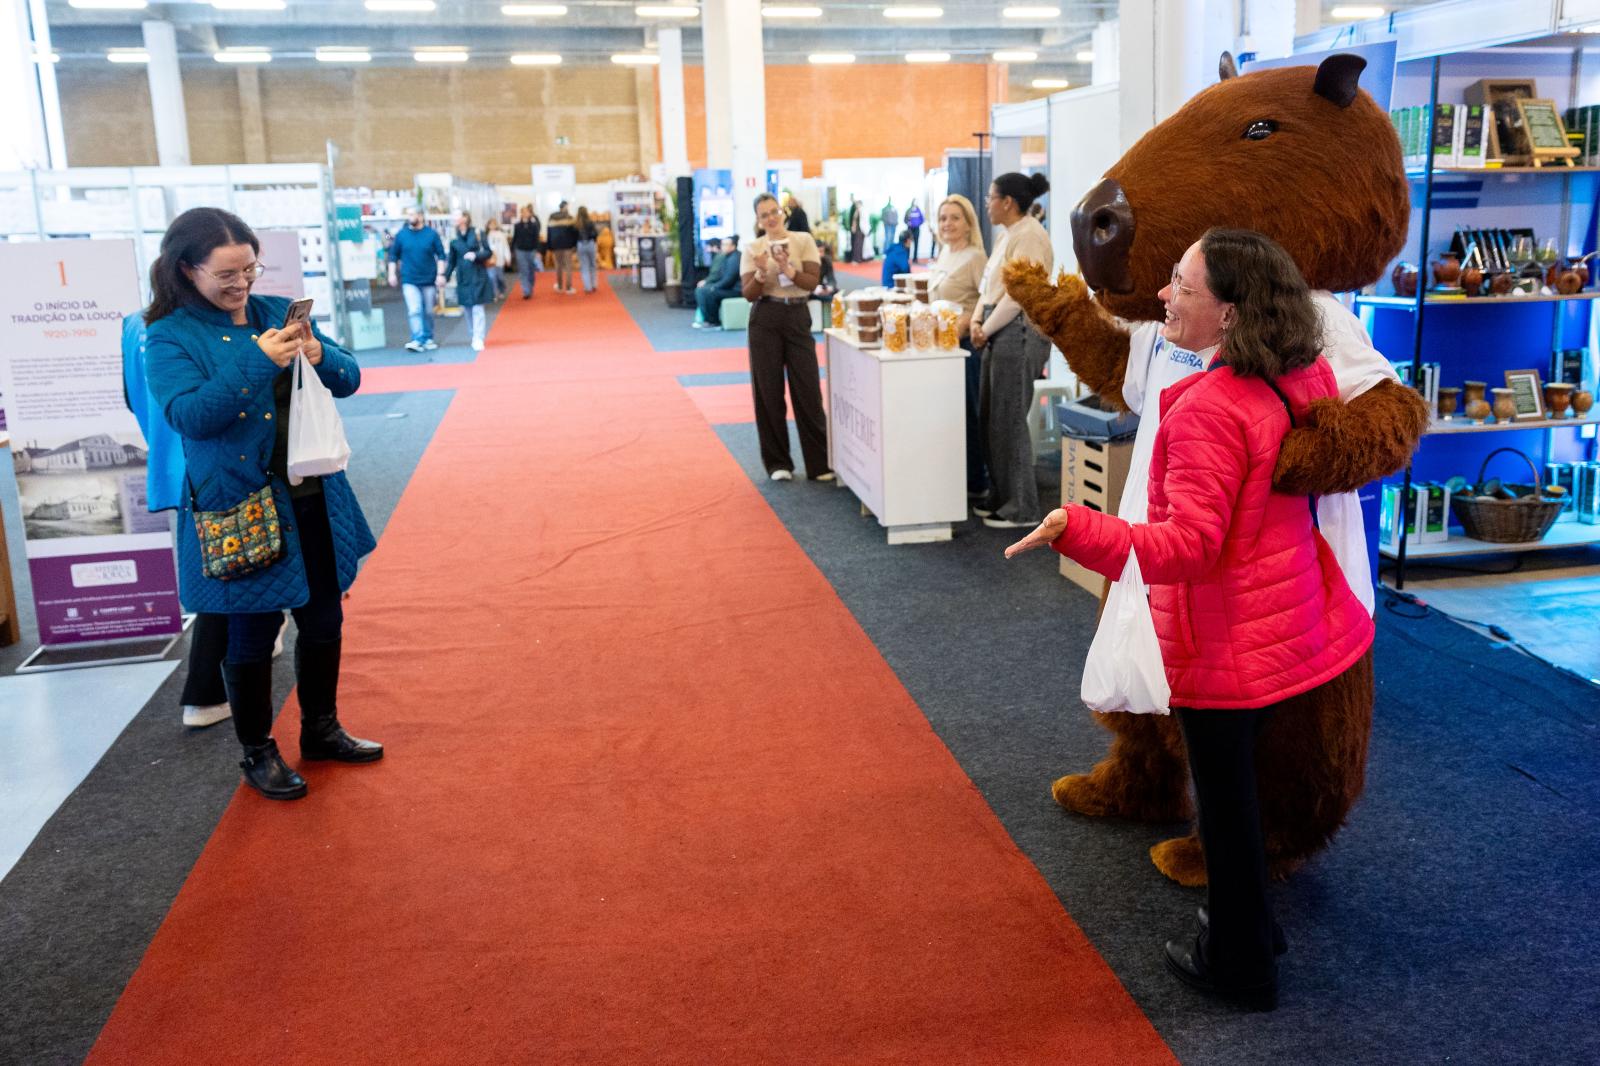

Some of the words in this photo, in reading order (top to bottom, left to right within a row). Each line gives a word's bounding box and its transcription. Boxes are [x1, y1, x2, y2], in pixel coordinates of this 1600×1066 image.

[34, 302, 43, 311] O
[46, 300, 80, 310] INÍCIO
[83, 300, 98, 309] DA
[11, 312, 66, 323] TRADIÇÃO
[70, 312, 85, 321] DA
[87, 311, 124, 321] LOUÇA
[43, 328, 97, 339] 1920-1950
[1170, 350, 1203, 370] SEBRA
